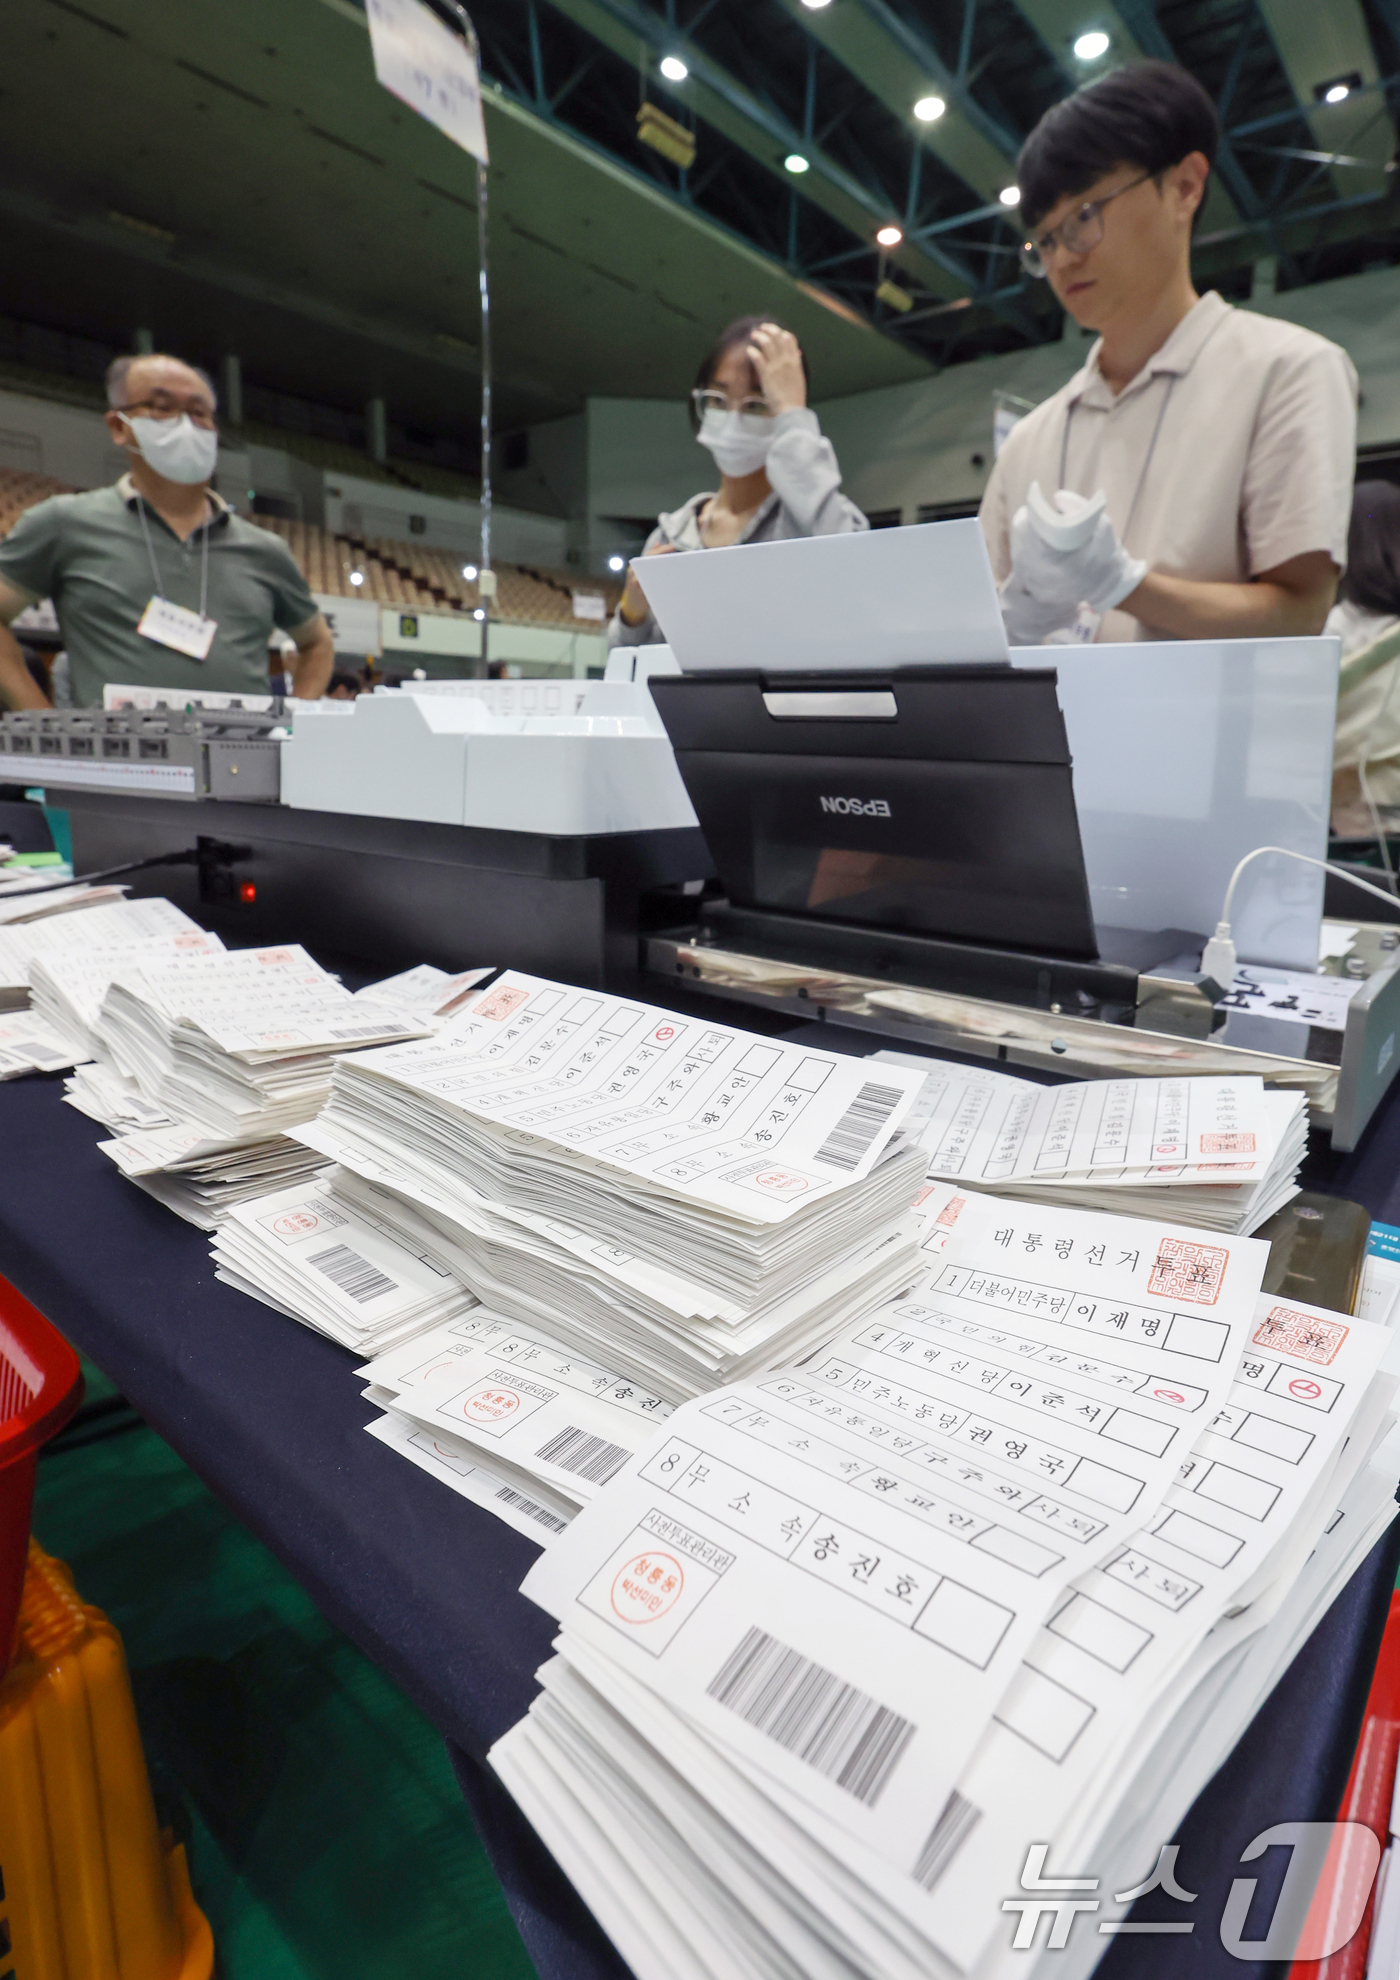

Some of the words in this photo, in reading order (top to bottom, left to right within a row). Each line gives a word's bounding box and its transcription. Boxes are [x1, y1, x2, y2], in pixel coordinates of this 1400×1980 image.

[820, 796, 891, 817] EPSON
[489, 1015, 534, 1054] 이재명
[525, 1025, 569, 1066] 김문수
[478, 1098, 489, 1106] 4
[566, 1036, 613, 1079] 이준석
[518, 1114, 534, 1123] 5
[608, 1049, 656, 1094] 권영국
[652, 1061, 702, 1109] 구주와
[696, 1034, 727, 1060] 사퇴
[615, 1149, 631, 1157] 7
[701, 1075, 751, 1124] 황교안
[670, 1168, 688, 1177] 8
[685, 1137, 759, 1169] 무소속
[754, 1092, 802, 1143] 송진호
[945, 1128, 969, 1154] 구주와
[1047, 1125, 1069, 1151] 이준석
[1103, 1122, 1124, 1146] 김문수
[1161, 1119, 1181, 1142] 이재명
[465, 1322, 481, 1332] 8
[946, 1274, 958, 1287] 1
[969, 1278, 1067, 1315] 더불어민주당
[1077, 1304, 1161, 1337] 이재명
[502, 1343, 519, 1354] 8
[524, 1349, 608, 1390] 무소속
[615, 1386, 678, 1418] 송진
[869, 1331, 885, 1343] 4
[891, 1339, 999, 1385] 개혁신당
[1009, 1381, 1102, 1424] 이준석
[909, 1308, 927, 1317] 2
[1045, 1353, 1135, 1386] 김문수
[825, 1367, 843, 1381] 5
[852, 1375, 959, 1431] 민주노동당
[968, 1425, 1066, 1476] 권영국
[721, 1403, 743, 1414] 7
[748, 1415, 861, 1475] 무소속
[871, 1475, 976, 1532] 황교안
[777, 1384, 796, 1394] 6
[800, 1394, 914, 1449] 자유통일당
[923, 1450, 1022, 1501] 구주와
[1029, 1503, 1096, 1536] 사퇴
[646, 1513, 730, 1571] 사전투표관리관
[659, 1453, 681, 1473] 8
[687, 1464, 802, 1543] 무소속
[813, 1533, 920, 1605] 송진호
[1115, 1559, 1190, 1602] 사퇴
